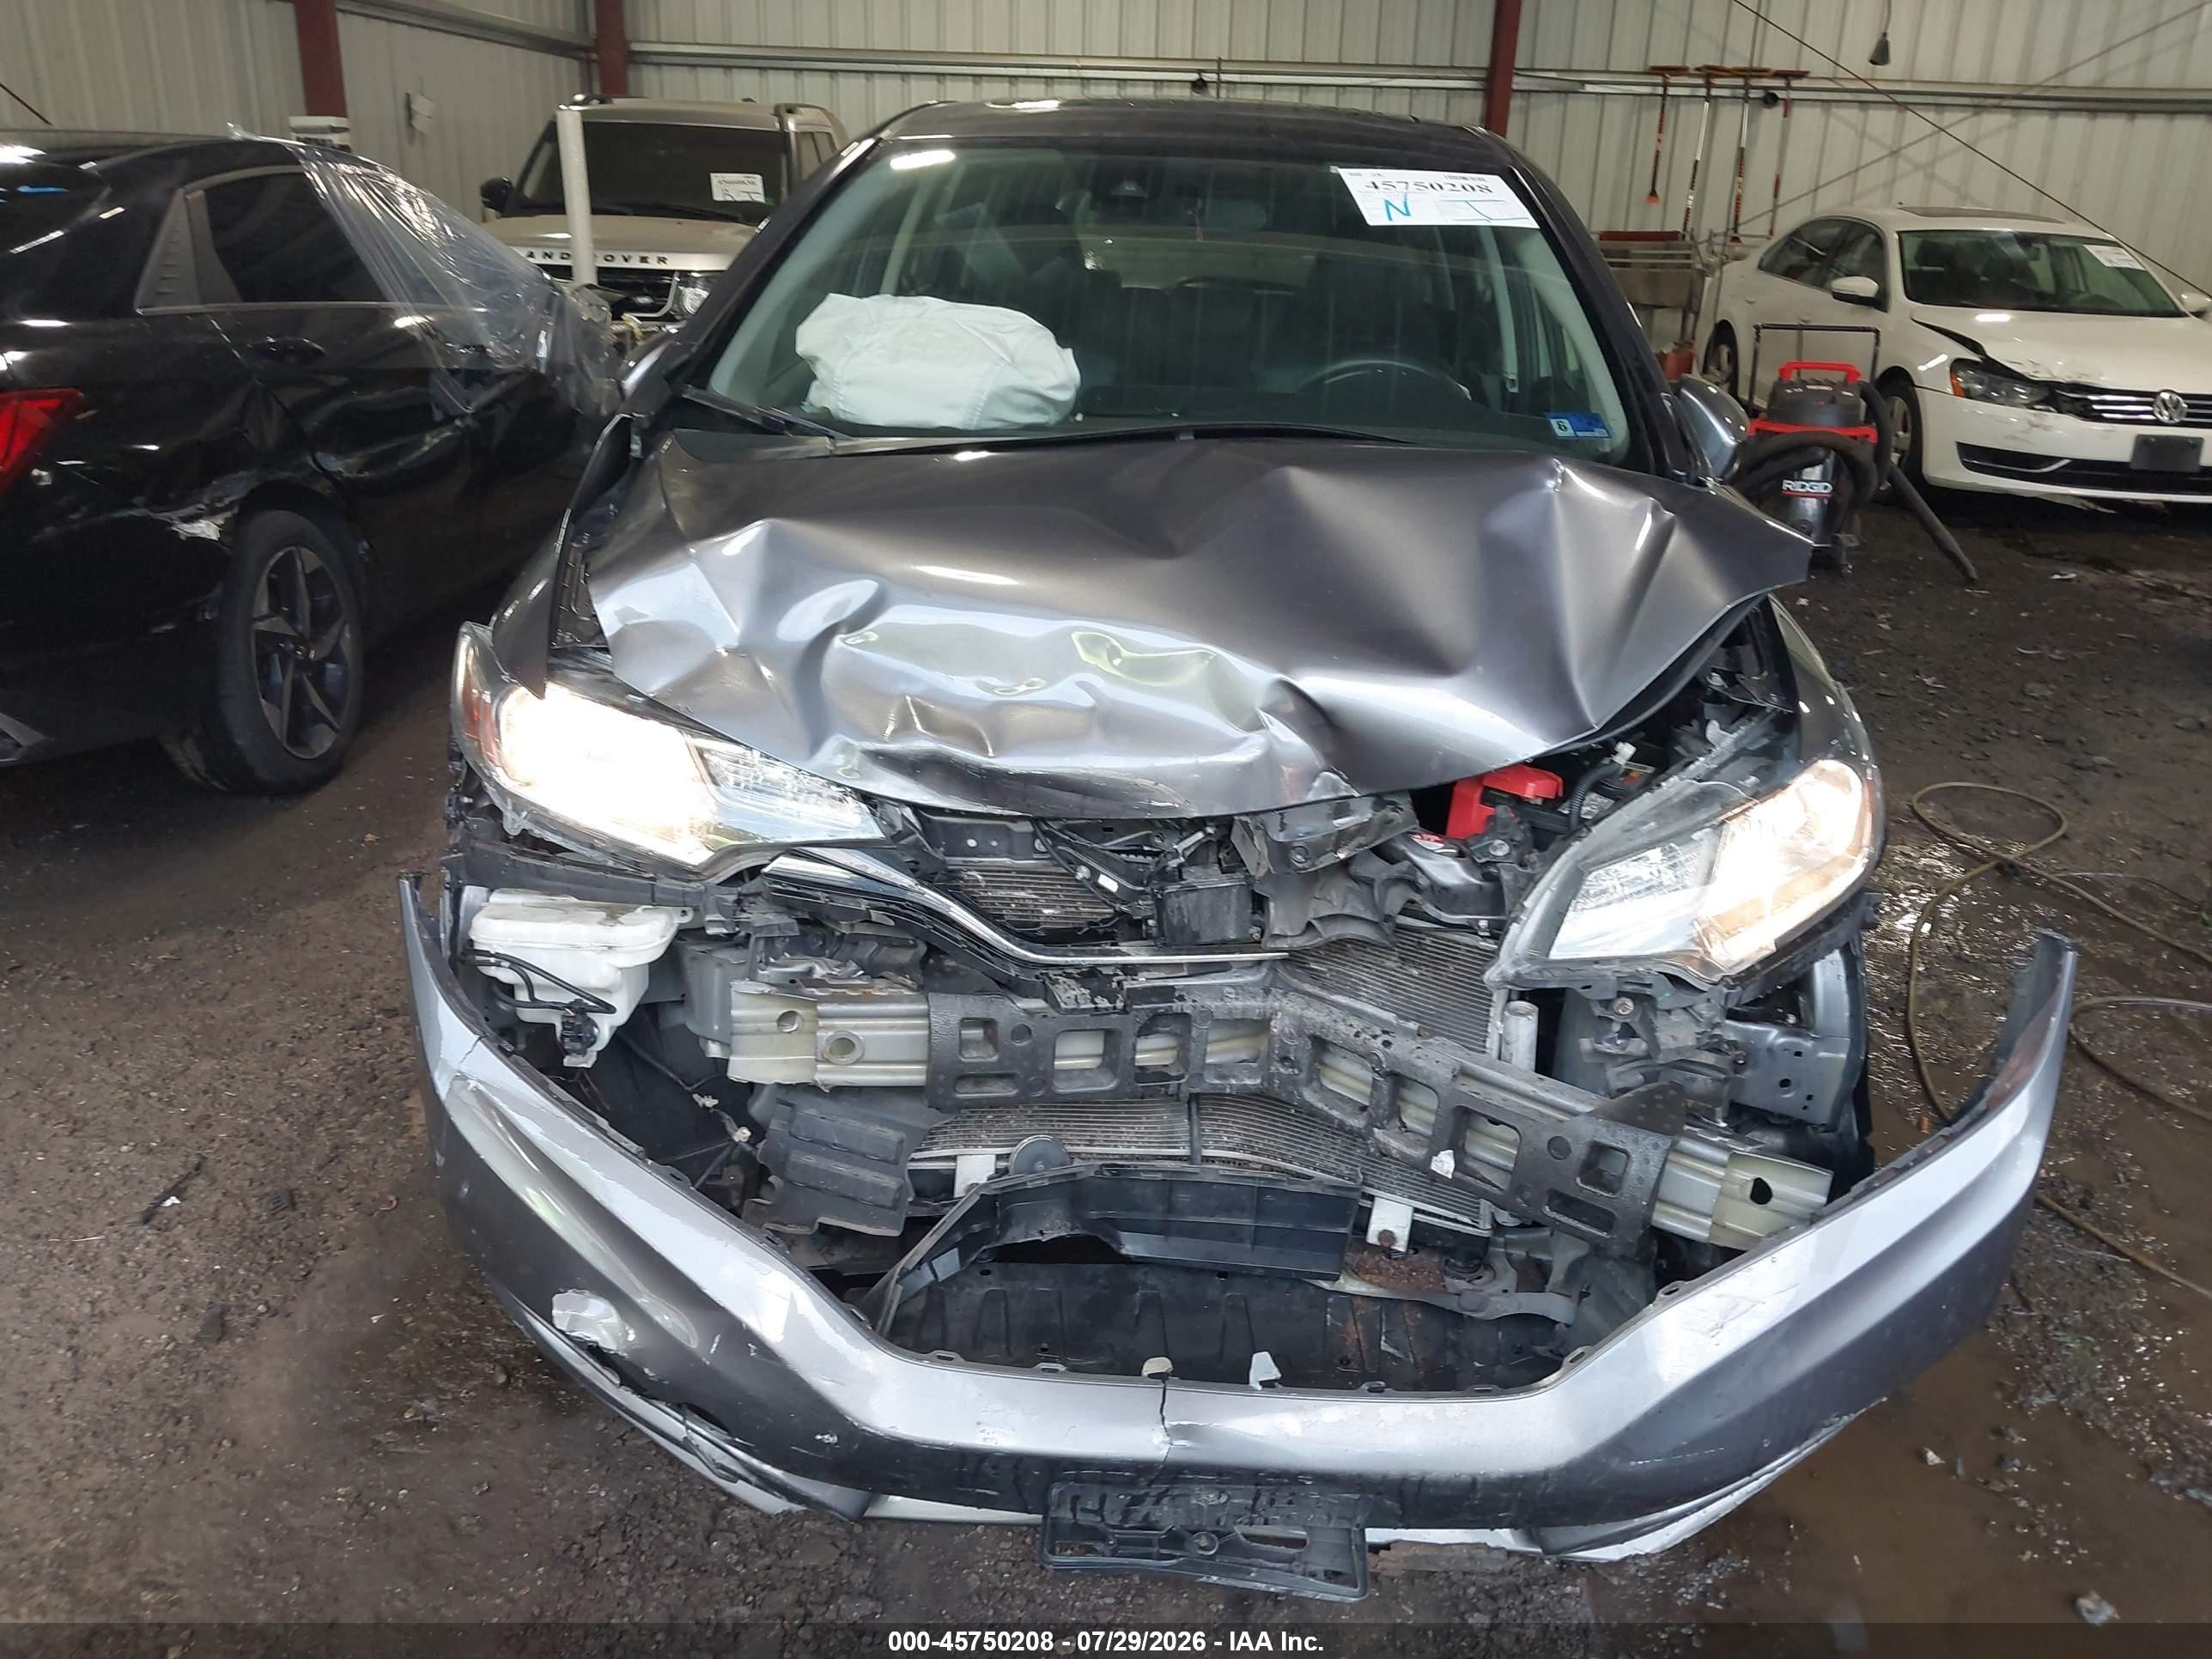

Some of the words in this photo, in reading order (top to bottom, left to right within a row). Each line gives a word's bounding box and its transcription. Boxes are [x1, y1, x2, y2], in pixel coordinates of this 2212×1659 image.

[1365, 180, 1493, 194] 45750208
[526, 250, 572, 260] AND
[594, 254, 668, 265] OVER
